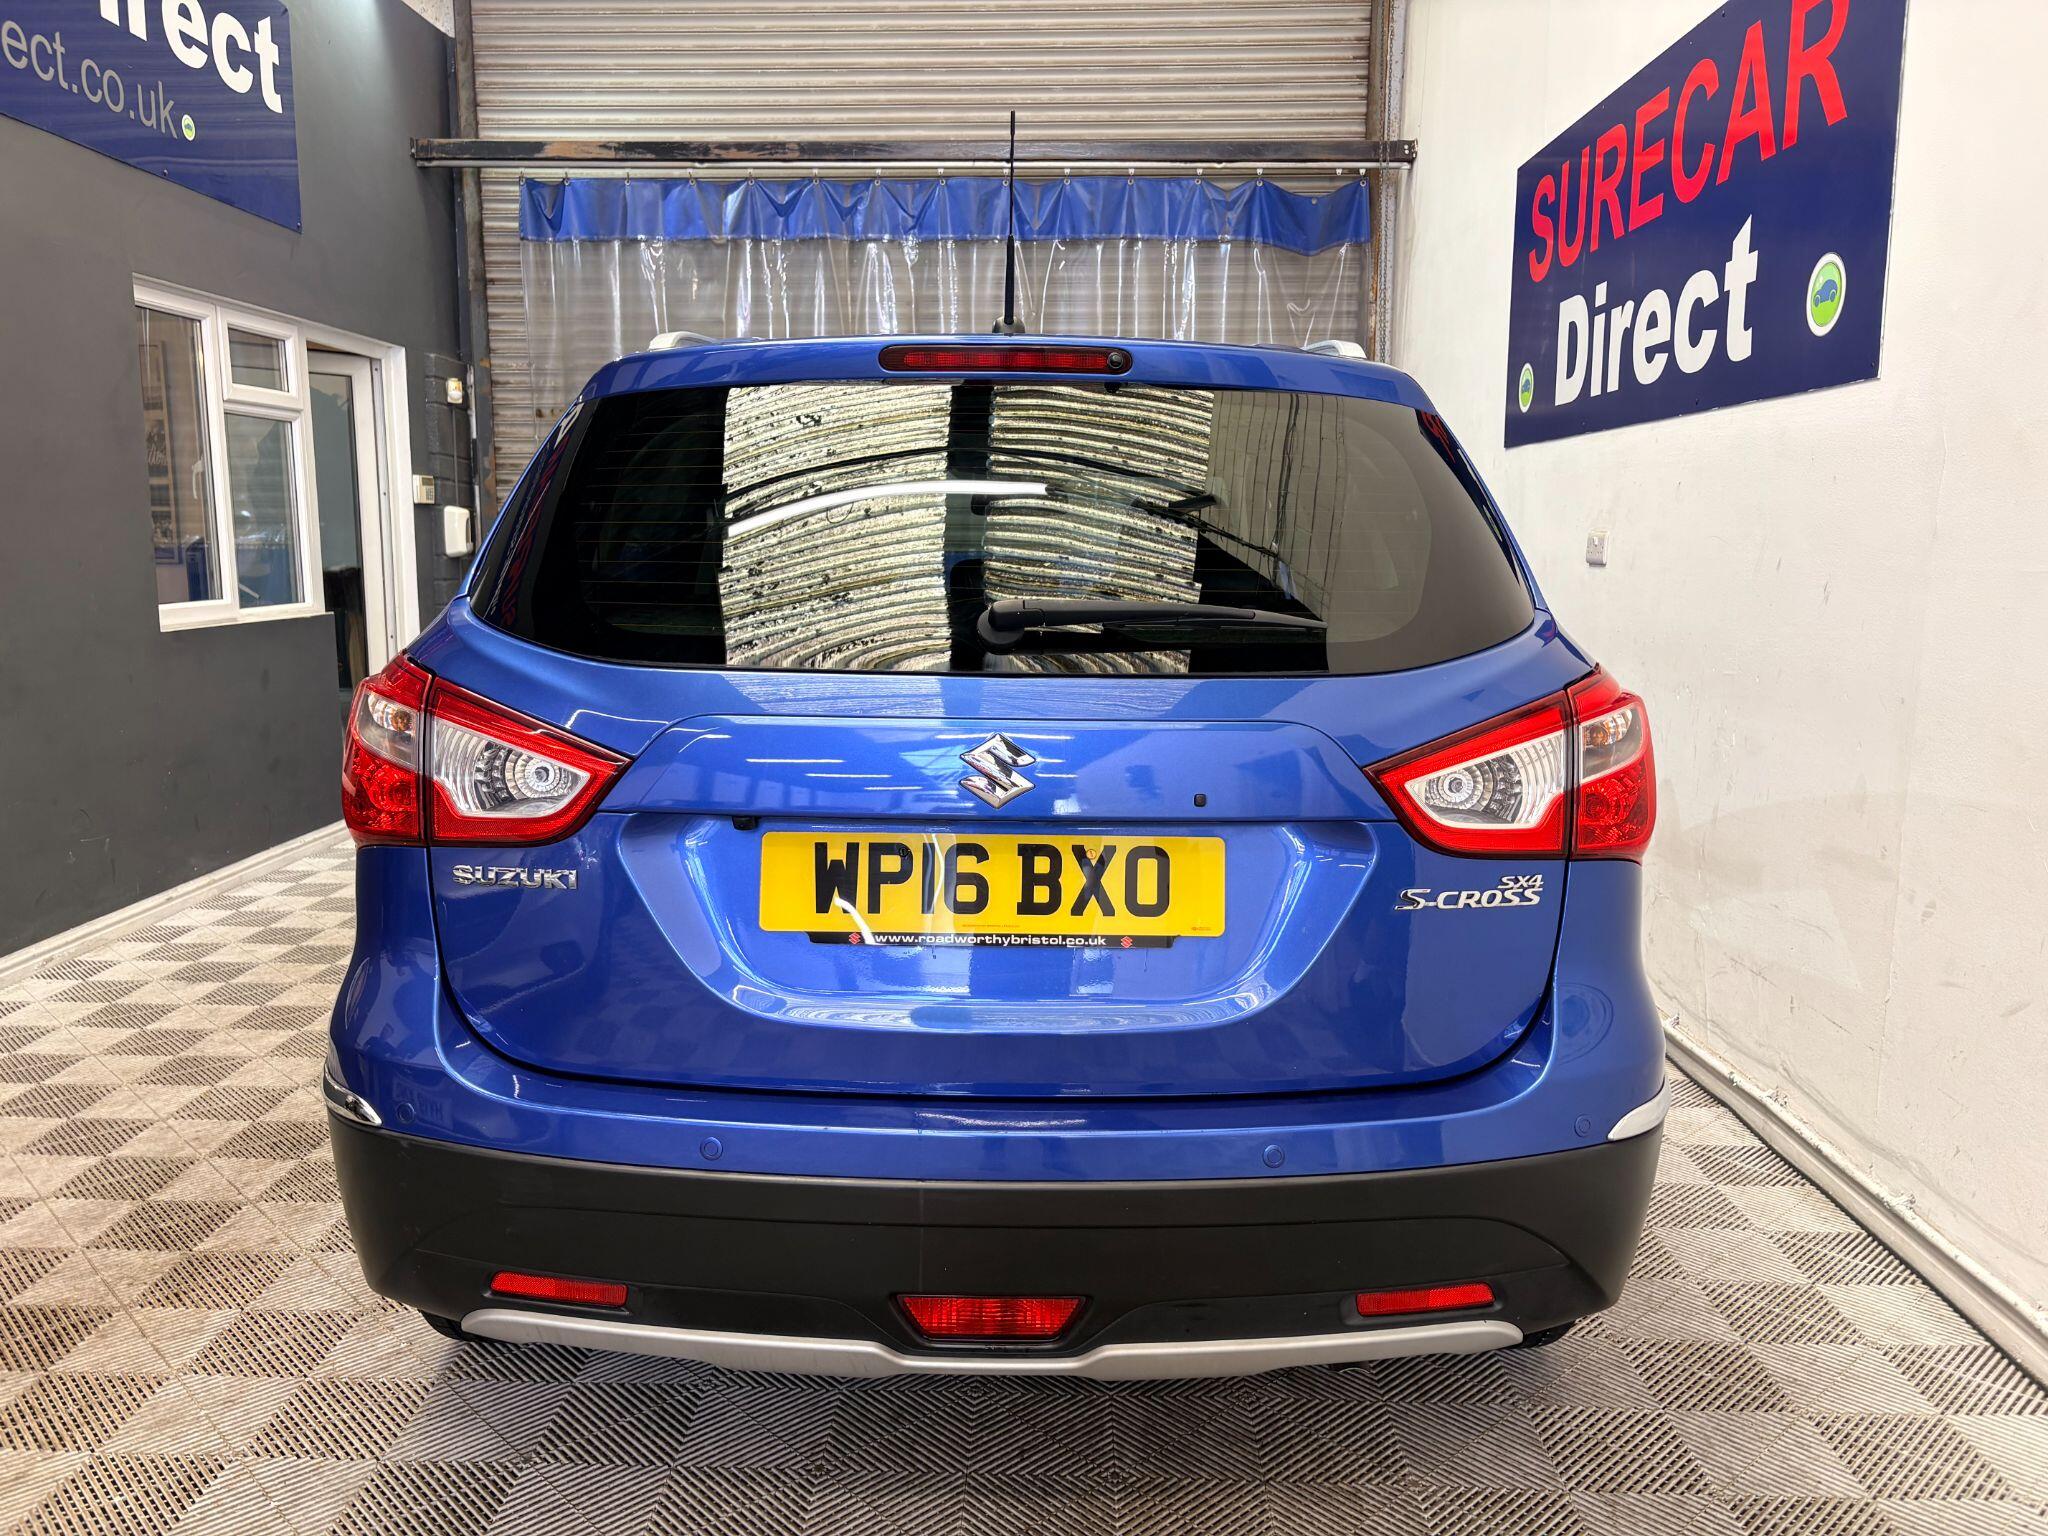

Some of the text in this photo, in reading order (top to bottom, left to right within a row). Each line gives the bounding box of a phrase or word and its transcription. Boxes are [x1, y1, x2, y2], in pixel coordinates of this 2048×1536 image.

[100, 0, 283, 114] ect
[1528, 0, 1850, 283] SURECAR
[1554, 214, 1759, 406] Direct
[452, 864, 578, 890] SUZUKI
[814, 842, 1171, 918] WP16 BXO
[1395, 888, 1543, 910] S-CROSS
[1498, 874, 1544, 888] SX4
[874, 934, 1107, 946] www.roadworthybristol.co.uk
